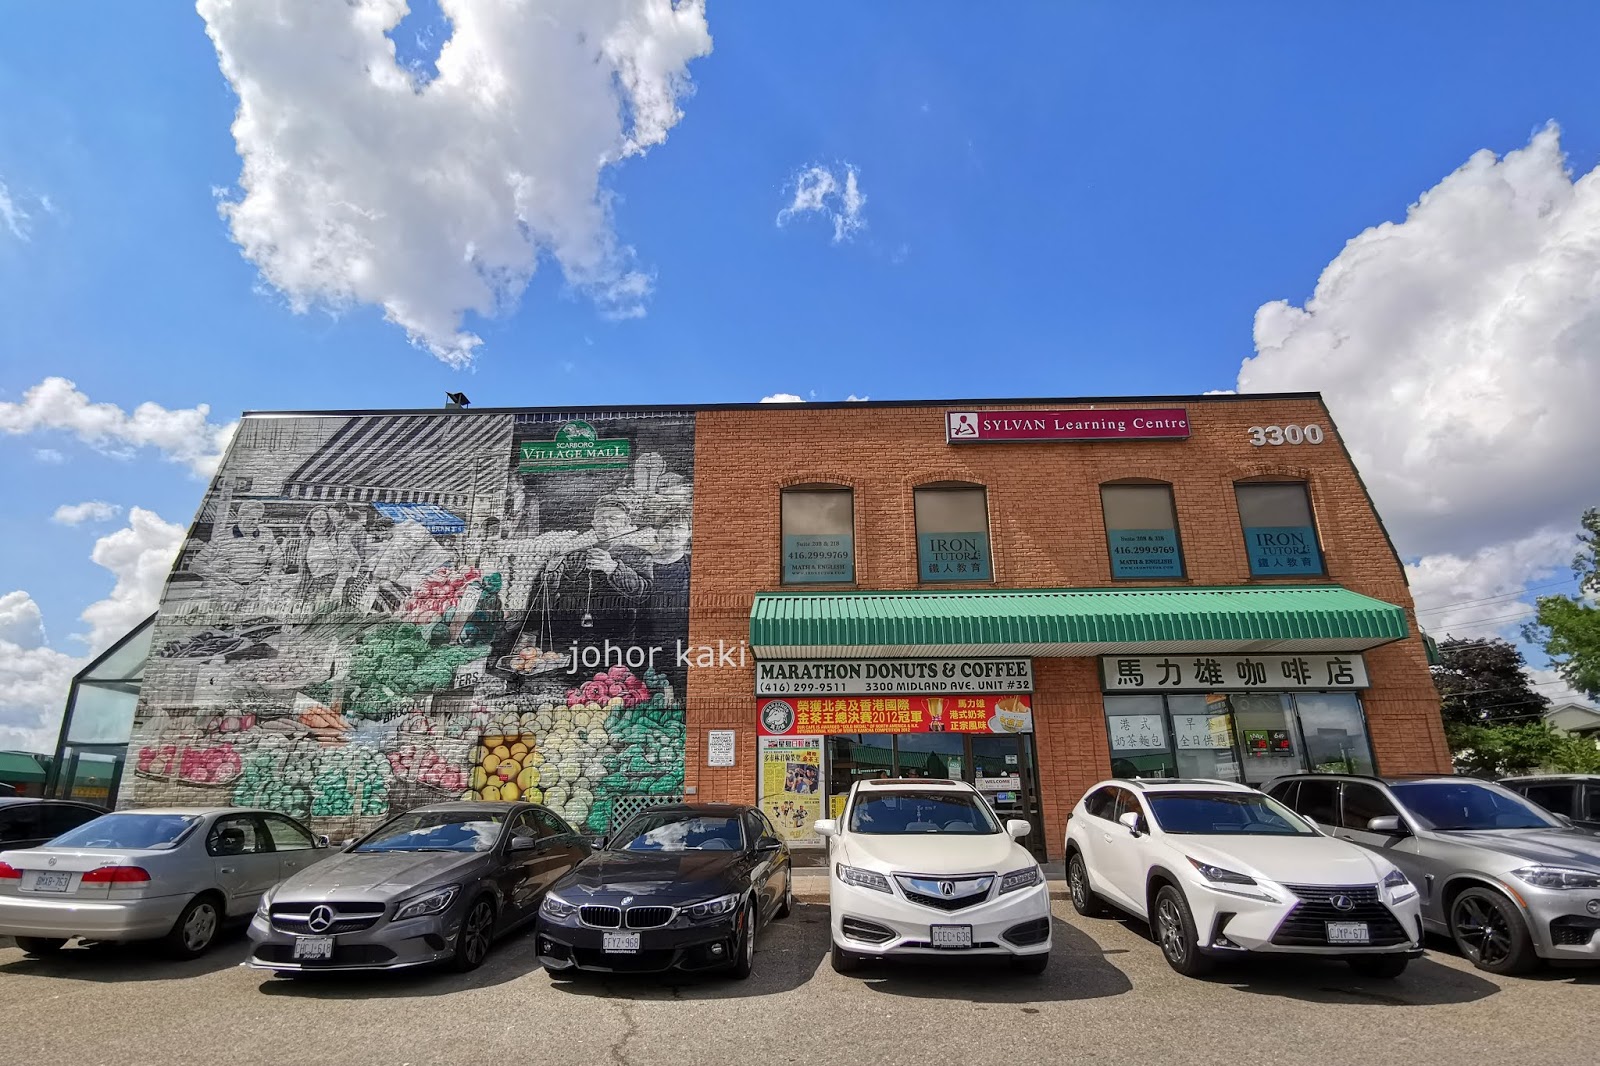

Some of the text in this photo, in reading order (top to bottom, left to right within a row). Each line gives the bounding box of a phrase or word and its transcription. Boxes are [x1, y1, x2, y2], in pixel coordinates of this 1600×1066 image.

[983, 418, 1187, 432] SYLVAN Learning Centre
[1248, 424, 1324, 446] 3300
[523, 446, 624, 459] VILLAGE MALL
[930, 538, 976, 552] IRON
[1256, 532, 1304, 546] IRON
[788, 551, 848, 559] 416.299.9769
[1114, 546, 1175, 554] 416.299.9769
[1260, 546, 1300, 555] TUTOR
[933, 552, 971, 561] TUTOR
[928, 562, 980, 574] 鐵人教育
[760, 661, 1028, 680] MARATHON DONUTS & COFFEE
[1117, 656, 1354, 686] 馬力雄咖啡店
[760, 680, 1030, 692] (416) 299-9511 3300 MIDLAND AVE. UNIT #32
[797, 699, 910, 711] 榮獲北美及香港國際
[958, 699, 985, 708] 馬力雄
[797, 711, 922, 724] 金茶王總決賽2012冠軍
[950, 710, 986, 719] 港式奶茶
[950, 721, 987, 730] 正宗風味
[1120, 718, 1150, 730] 港式
[1180, 734, 1227, 747] 全日供應
